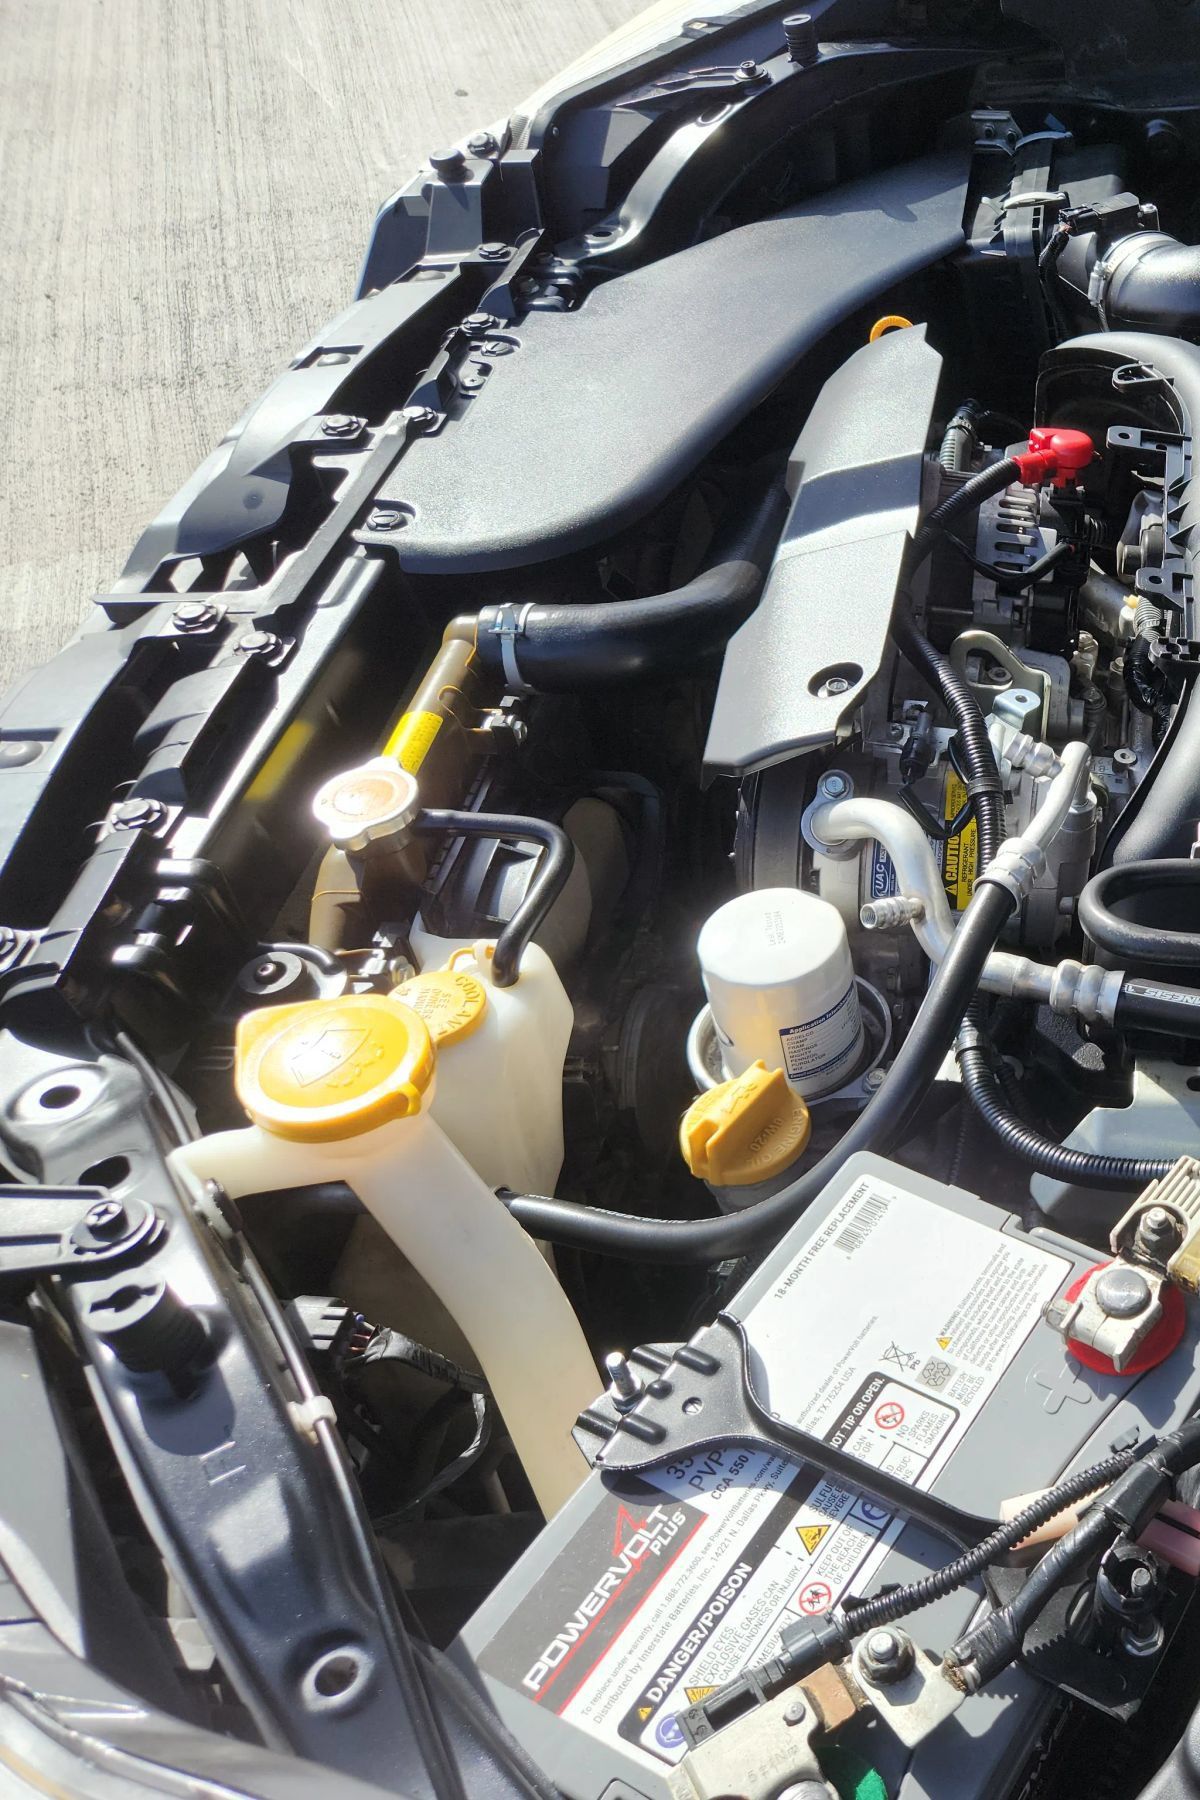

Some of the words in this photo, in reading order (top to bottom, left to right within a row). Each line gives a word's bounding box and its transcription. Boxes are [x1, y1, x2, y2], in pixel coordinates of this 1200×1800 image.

[943, 834, 962, 881] CAUTIO
[967, 828, 977, 857] PRESSURE
[873, 863, 886, 889] UAC
[959, 842, 971, 882] REFRIGERANT
[965, 878, 973, 896] UNDER
[772, 1254, 813, 1301] 18-MONTH
[807, 1234, 828, 1257] FREE
[822, 1180, 871, 1238] REPLACEMENT
[839, 1363, 857, 1383] USA
[909, 1357, 921, 1371] Pb
[824, 1379, 846, 1405] 75254
[947, 1370, 968, 1398] BATTERY
[954, 1381, 971, 1402] MUST
[961, 1375, 985, 1407] RECYCLED
[816, 1400, 831, 1416] TX
[839, 1413, 858, 1433] TIP
[852, 1399, 867, 1415] OR
[860, 1374, 885, 1404] OPEN.
[895, 1423, 910, 1439] NO
[906, 1408, 930, 1438] SPARKS
[915, 1411, 939, 1442] FLAMES
[923, 1411, 950, 1446] SMOKING
[851, 1433, 868, 1453] CAN
[687, 1439, 734, 1494] PVP-
[709, 1474, 734, 1502] CCA
[727, 1452, 750, 1477] 550
[769, 1457, 789, 1481] Suite
[753, 1477, 777, 1504] Pkwy,
[816, 1490, 840, 1518] CAUSE
[735, 1500, 759, 1528] Dallas
[825, 1491, 850, 1522] SEVERE
[580, 1703, 593, 1717] To
[588, 1675, 615, 1707] replace
[608, 1654, 630, 1678] under
[624, 1620, 656, 1658] warranty,
[648, 1606, 664, 1623] call
[708, 1452, 778, 1544] PowerVoltBatteries.com/wa
[795, 1391, 822, 1425] authorized
[817, 1373, 835, 1394] dealer
[835, 1337, 862, 1370] PowerVolt
[647, 1509, 688, 1556] PLUS
[727, 1523, 741, 1538] N.
[708, 1535, 734, 1565] 14221
[814, 1552, 835, 1577] KEEP
[829, 1534, 847, 1555] OUT
[841, 1522, 855, 1537] OF
[823, 1562, 840, 1581] THE
[835, 1533, 859, 1564] REACH
[831, 1571, 845, 1586] OF
[839, 1527, 875, 1574] CHILDREN.
[695, 1560, 716, 1583] Inc.,
[519, 1501, 674, 1694] POWERVOLT
[666, 1578, 703, 1623] Batteries,
[645, 1558, 754, 1705] DANGER/POISON
[701, 1628, 746, 1685] EXPLOSIVE
[738, 1596, 768, 1632] GASES
[762, 1579, 780, 1600] CAN
[716, 1649, 744, 1682] CAUSE
[736, 1603, 775, 1654] BLINDNESS
[767, 1591, 783, 1608] OR
[775, 1563, 803, 1596] INJURY.
[635, 1618, 674, 1664] Interstate
[627, 1660, 645, 1678] by
[687, 1648, 719, 1687] SHIELD
[591, 1672, 635, 1725] Distributed
